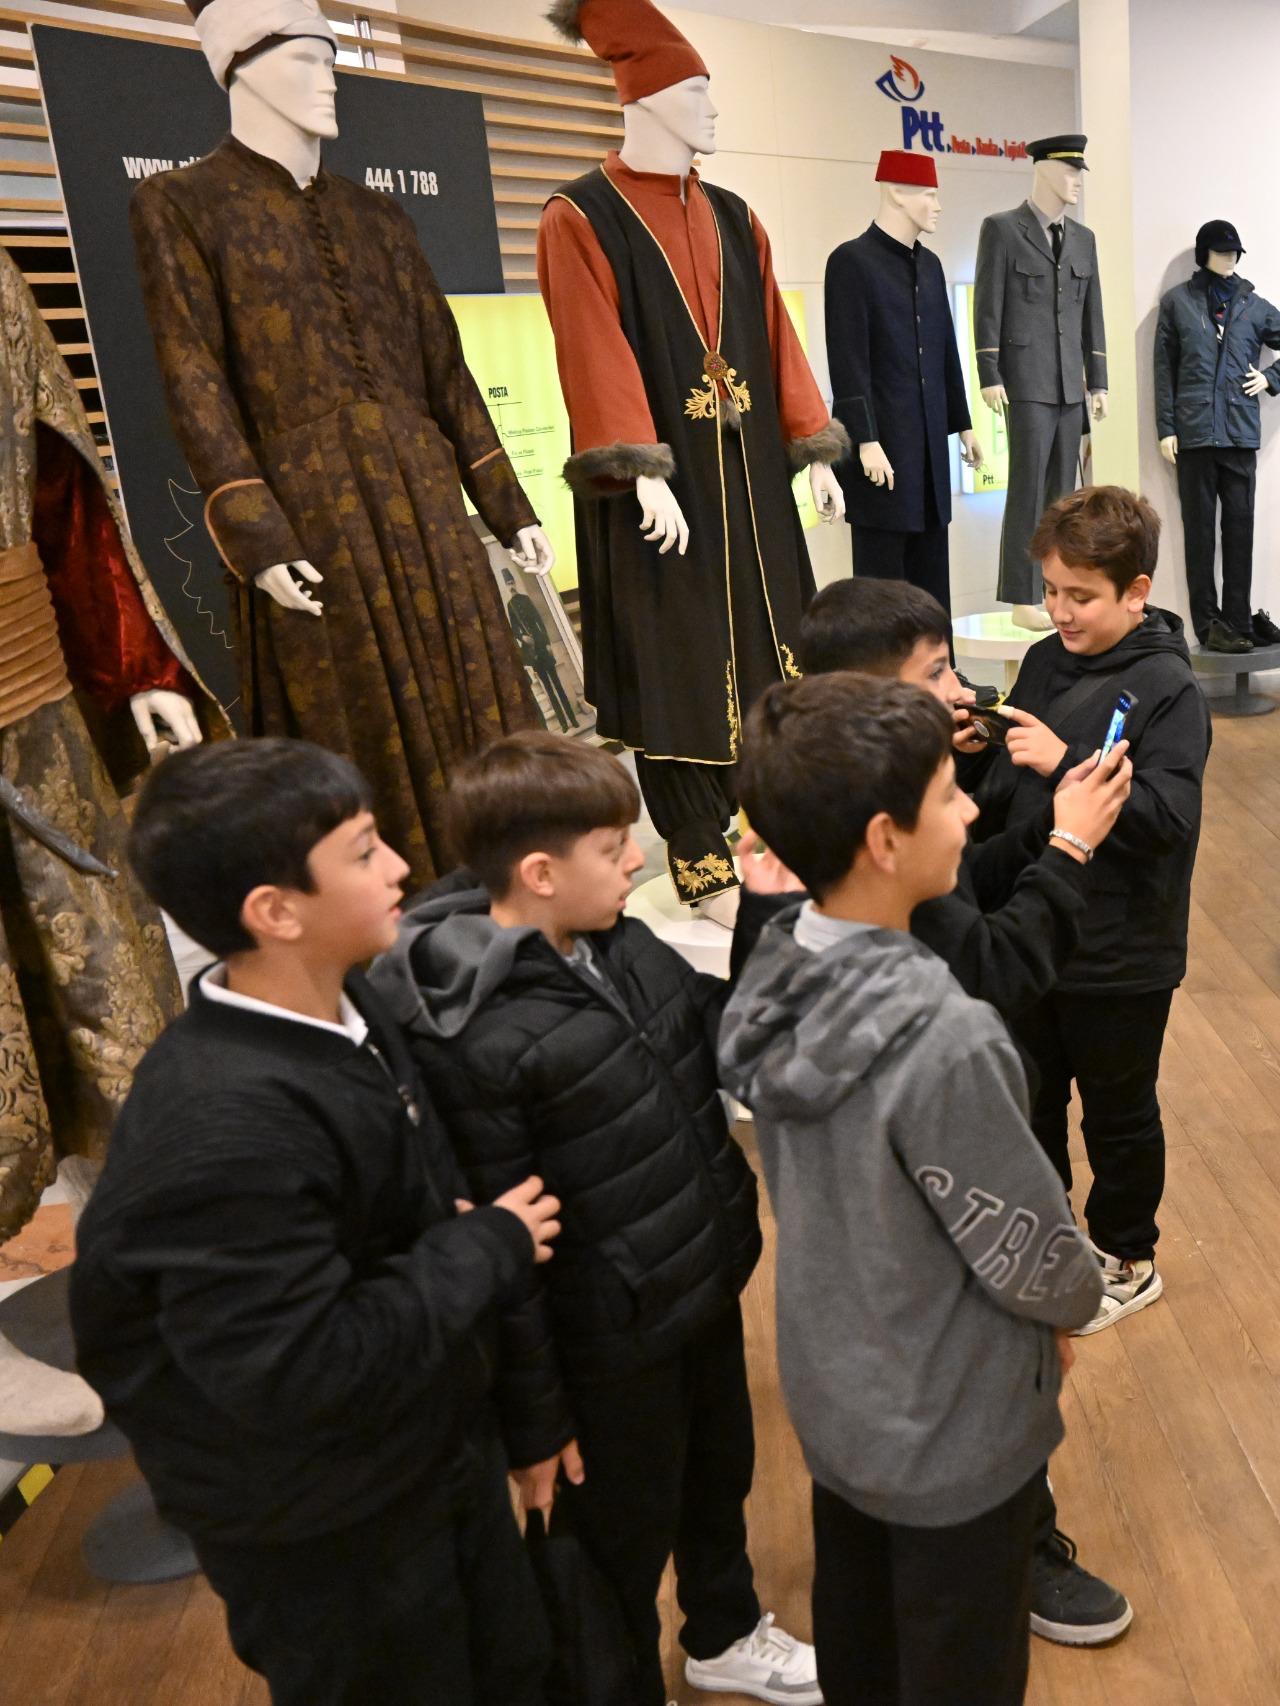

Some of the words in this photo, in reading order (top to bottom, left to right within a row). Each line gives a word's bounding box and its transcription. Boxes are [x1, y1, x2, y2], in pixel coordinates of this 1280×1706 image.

[901, 106, 944, 151] Ptt
[365, 167, 394, 193] 444
[397, 169, 406, 194] 1
[410, 170, 439, 195] 788
[488, 386, 508, 399] POSTA
[983, 474, 994, 485] Ptt
